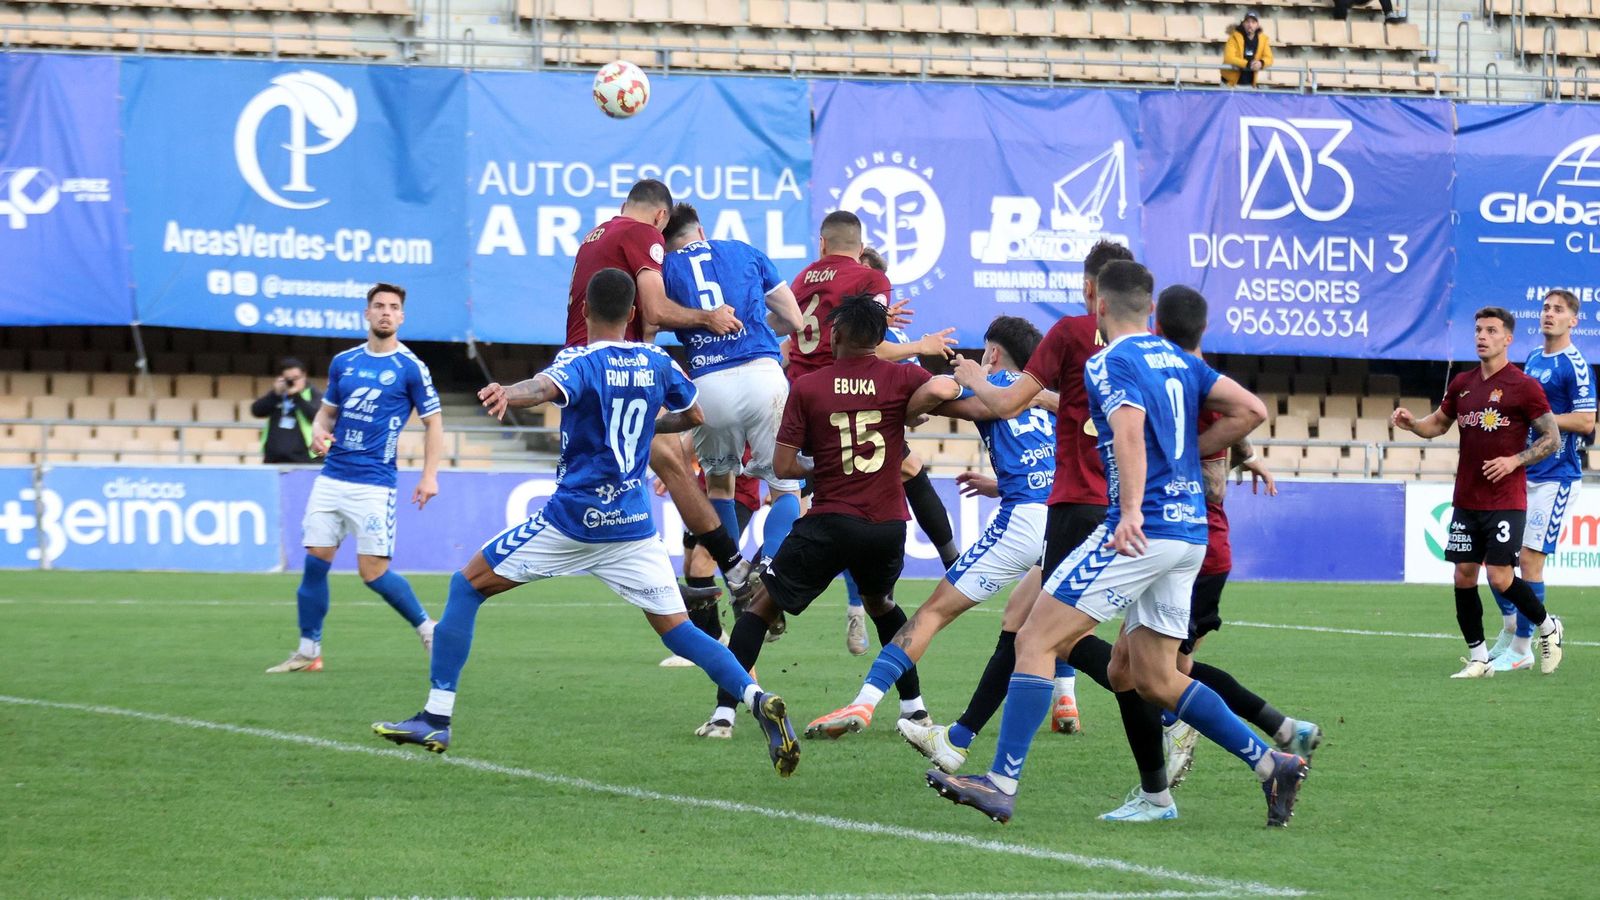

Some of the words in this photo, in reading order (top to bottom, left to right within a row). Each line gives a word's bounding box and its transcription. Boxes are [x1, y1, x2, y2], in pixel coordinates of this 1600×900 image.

[845, 151, 934, 181] JUNGLA
[1479, 191, 1600, 226] Globa
[163, 221, 433, 265] AreasVerdes-CP.com
[477, 205, 806, 258] ARAL
[1565, 231, 1600, 254] CL
[1188, 233, 1376, 272] DICTAMEN
[1385, 235, 1409, 274] 3
[262, 274, 373, 299] @areasverdes
[688, 253, 726, 312] 5
[803, 266, 838, 284] PELÓN
[895, 267, 946, 300] EREZ
[973, 270, 1047, 289] HERMANOS
[1235, 278, 1360, 303] ASESORES
[796, 294, 822, 355] 6
[1226, 307, 1369, 338] 956326334
[834, 377, 876, 396] EBUKA
[356, 401, 379, 414] Air
[829, 410, 887, 475] 15
[1496, 520, 1511, 543] 3
[1560, 552, 1600, 568] HERM
